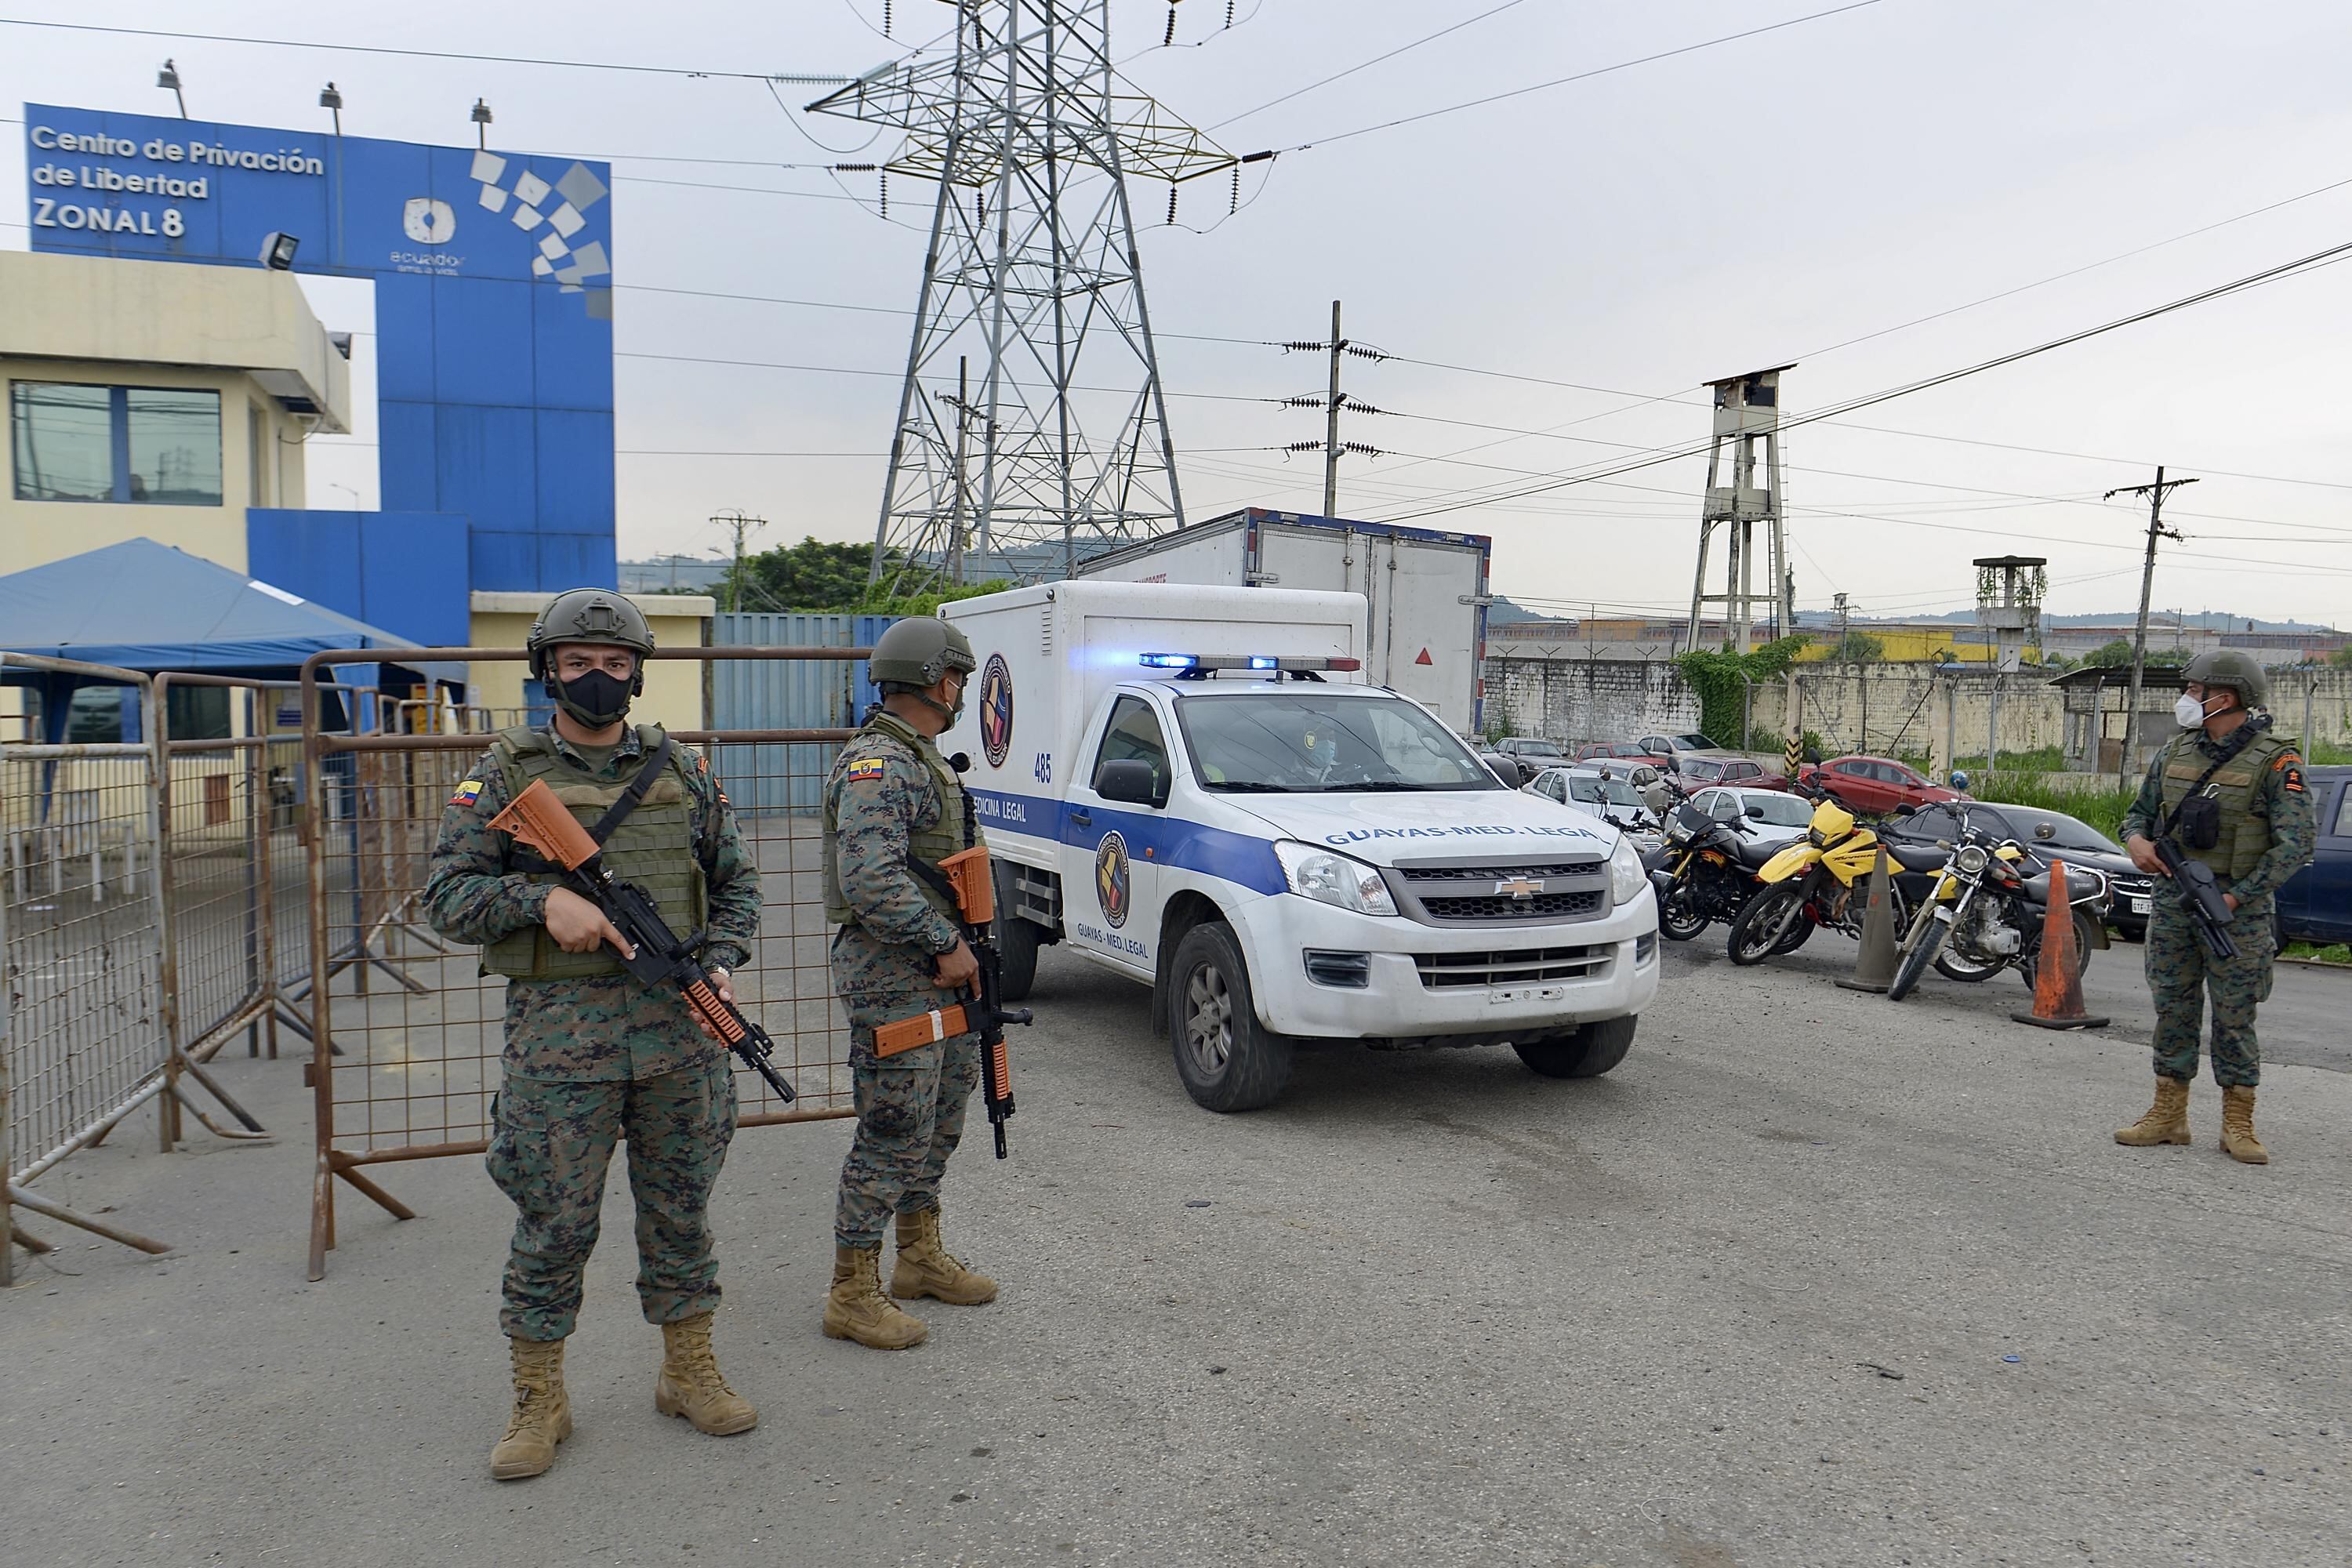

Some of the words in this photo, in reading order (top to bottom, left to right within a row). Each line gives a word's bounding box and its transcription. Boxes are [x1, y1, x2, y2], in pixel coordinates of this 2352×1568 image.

[31, 125, 137, 158] Centro
[143, 138, 185, 162] de
[189, 141, 324, 176] Privación
[32, 162, 76, 187] de
[81, 166, 209, 199] Libertad
[33, 198, 157, 235] ZONAL
[162, 208, 184, 238] 8
[1034, 752, 1051, 784] 485
[974, 796, 1000, 818] EDICINA
[1002, 800, 1026, 822] LEGAL
[1526, 826, 1612, 845] LEGAL
[1077, 923, 1102, 943] GUAYAS
[1106, 932, 1125, 951] MED.
[1124, 938, 1149, 959] LEGAL
